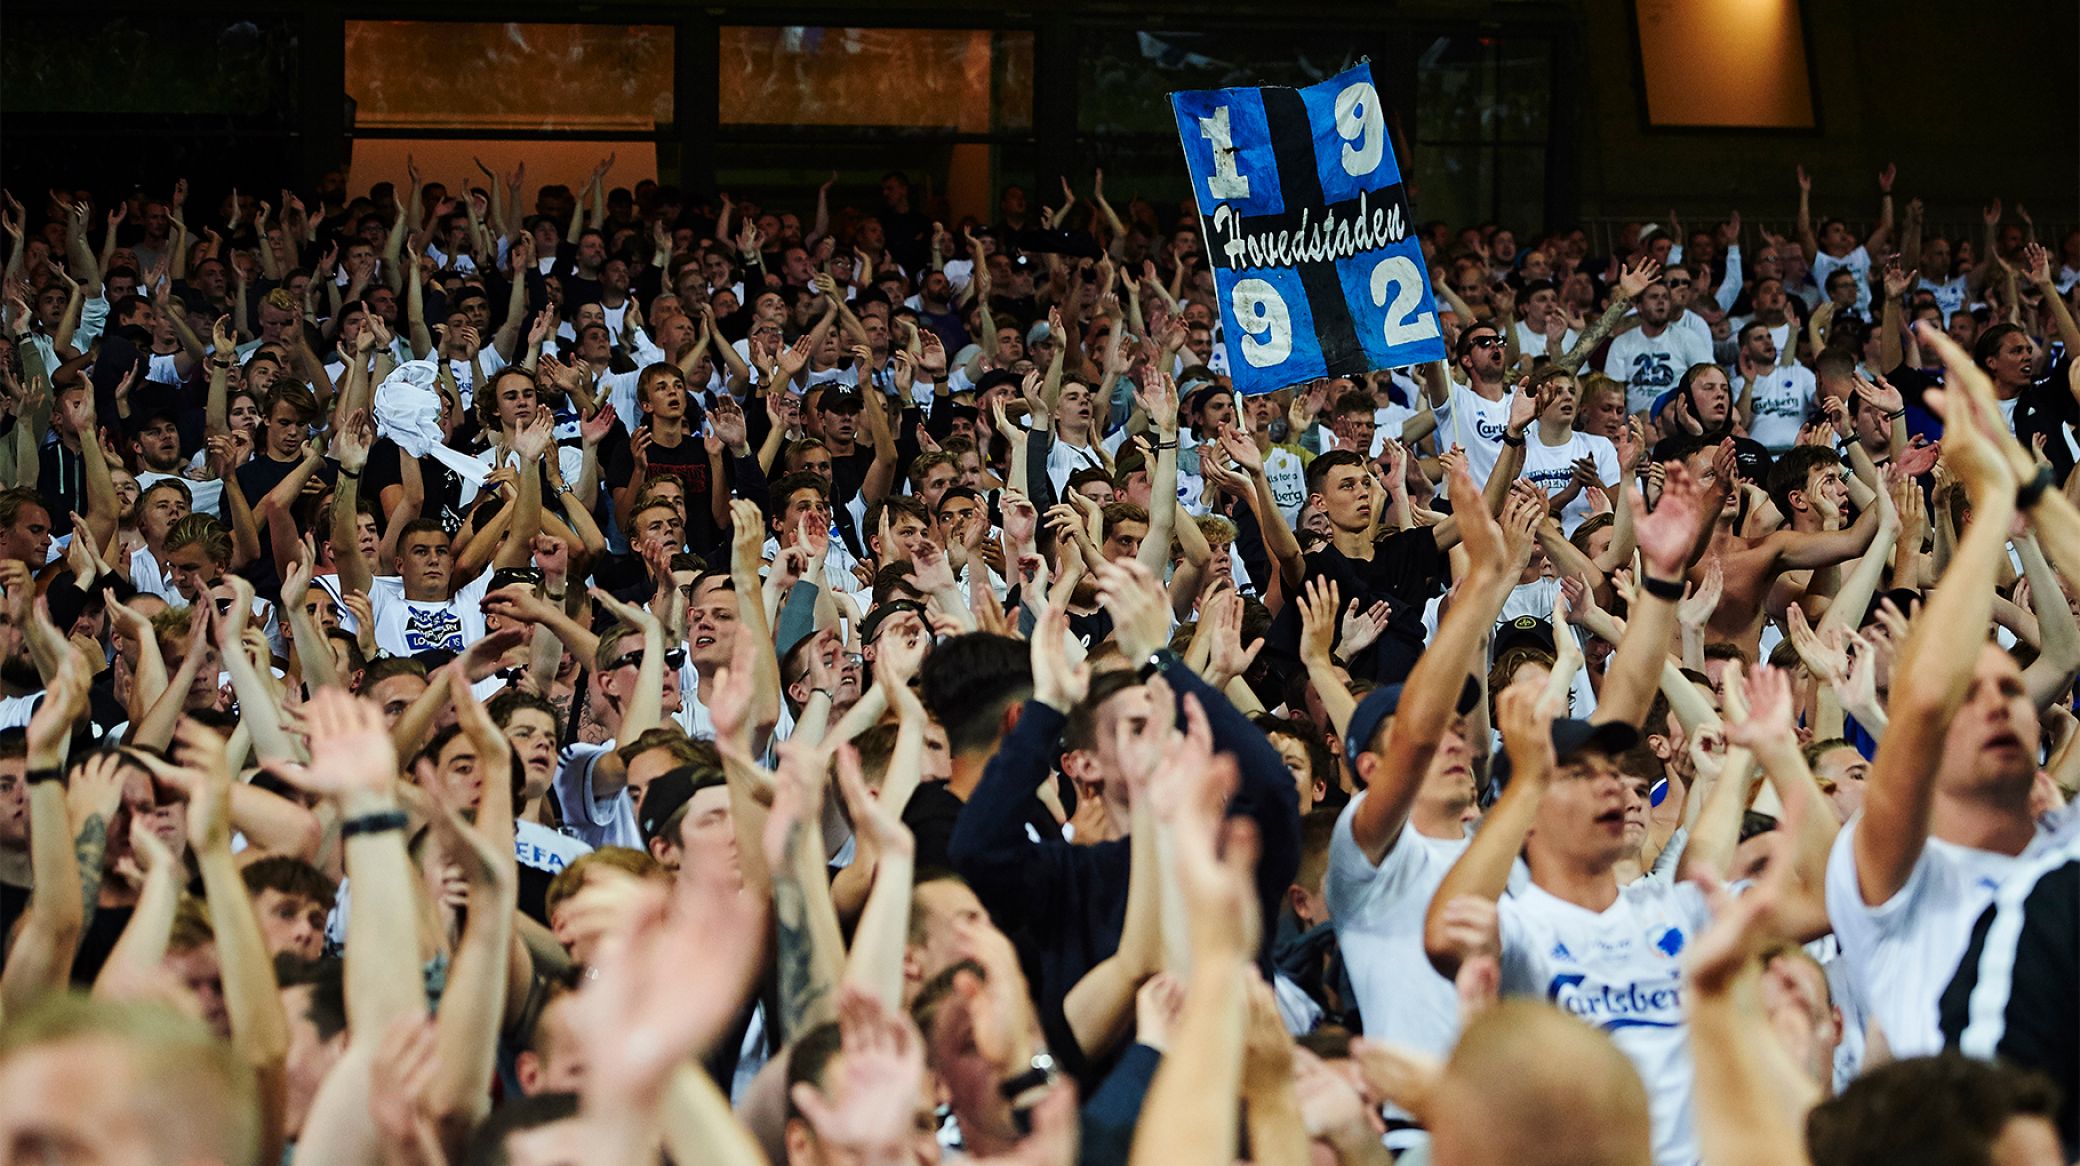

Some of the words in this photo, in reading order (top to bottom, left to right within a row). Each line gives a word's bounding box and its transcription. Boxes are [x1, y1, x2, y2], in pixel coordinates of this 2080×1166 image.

[1199, 105, 1250, 199] 1
[1335, 82, 1384, 177] 9
[1213, 191, 1405, 270] Hovedstaden
[1231, 279, 1292, 368] 9
[1370, 256, 1440, 347] 2
[1632, 353, 1674, 387] 25
[515, 841, 566, 868] EFA
[1547, 974, 1681, 1015] Carlsber
